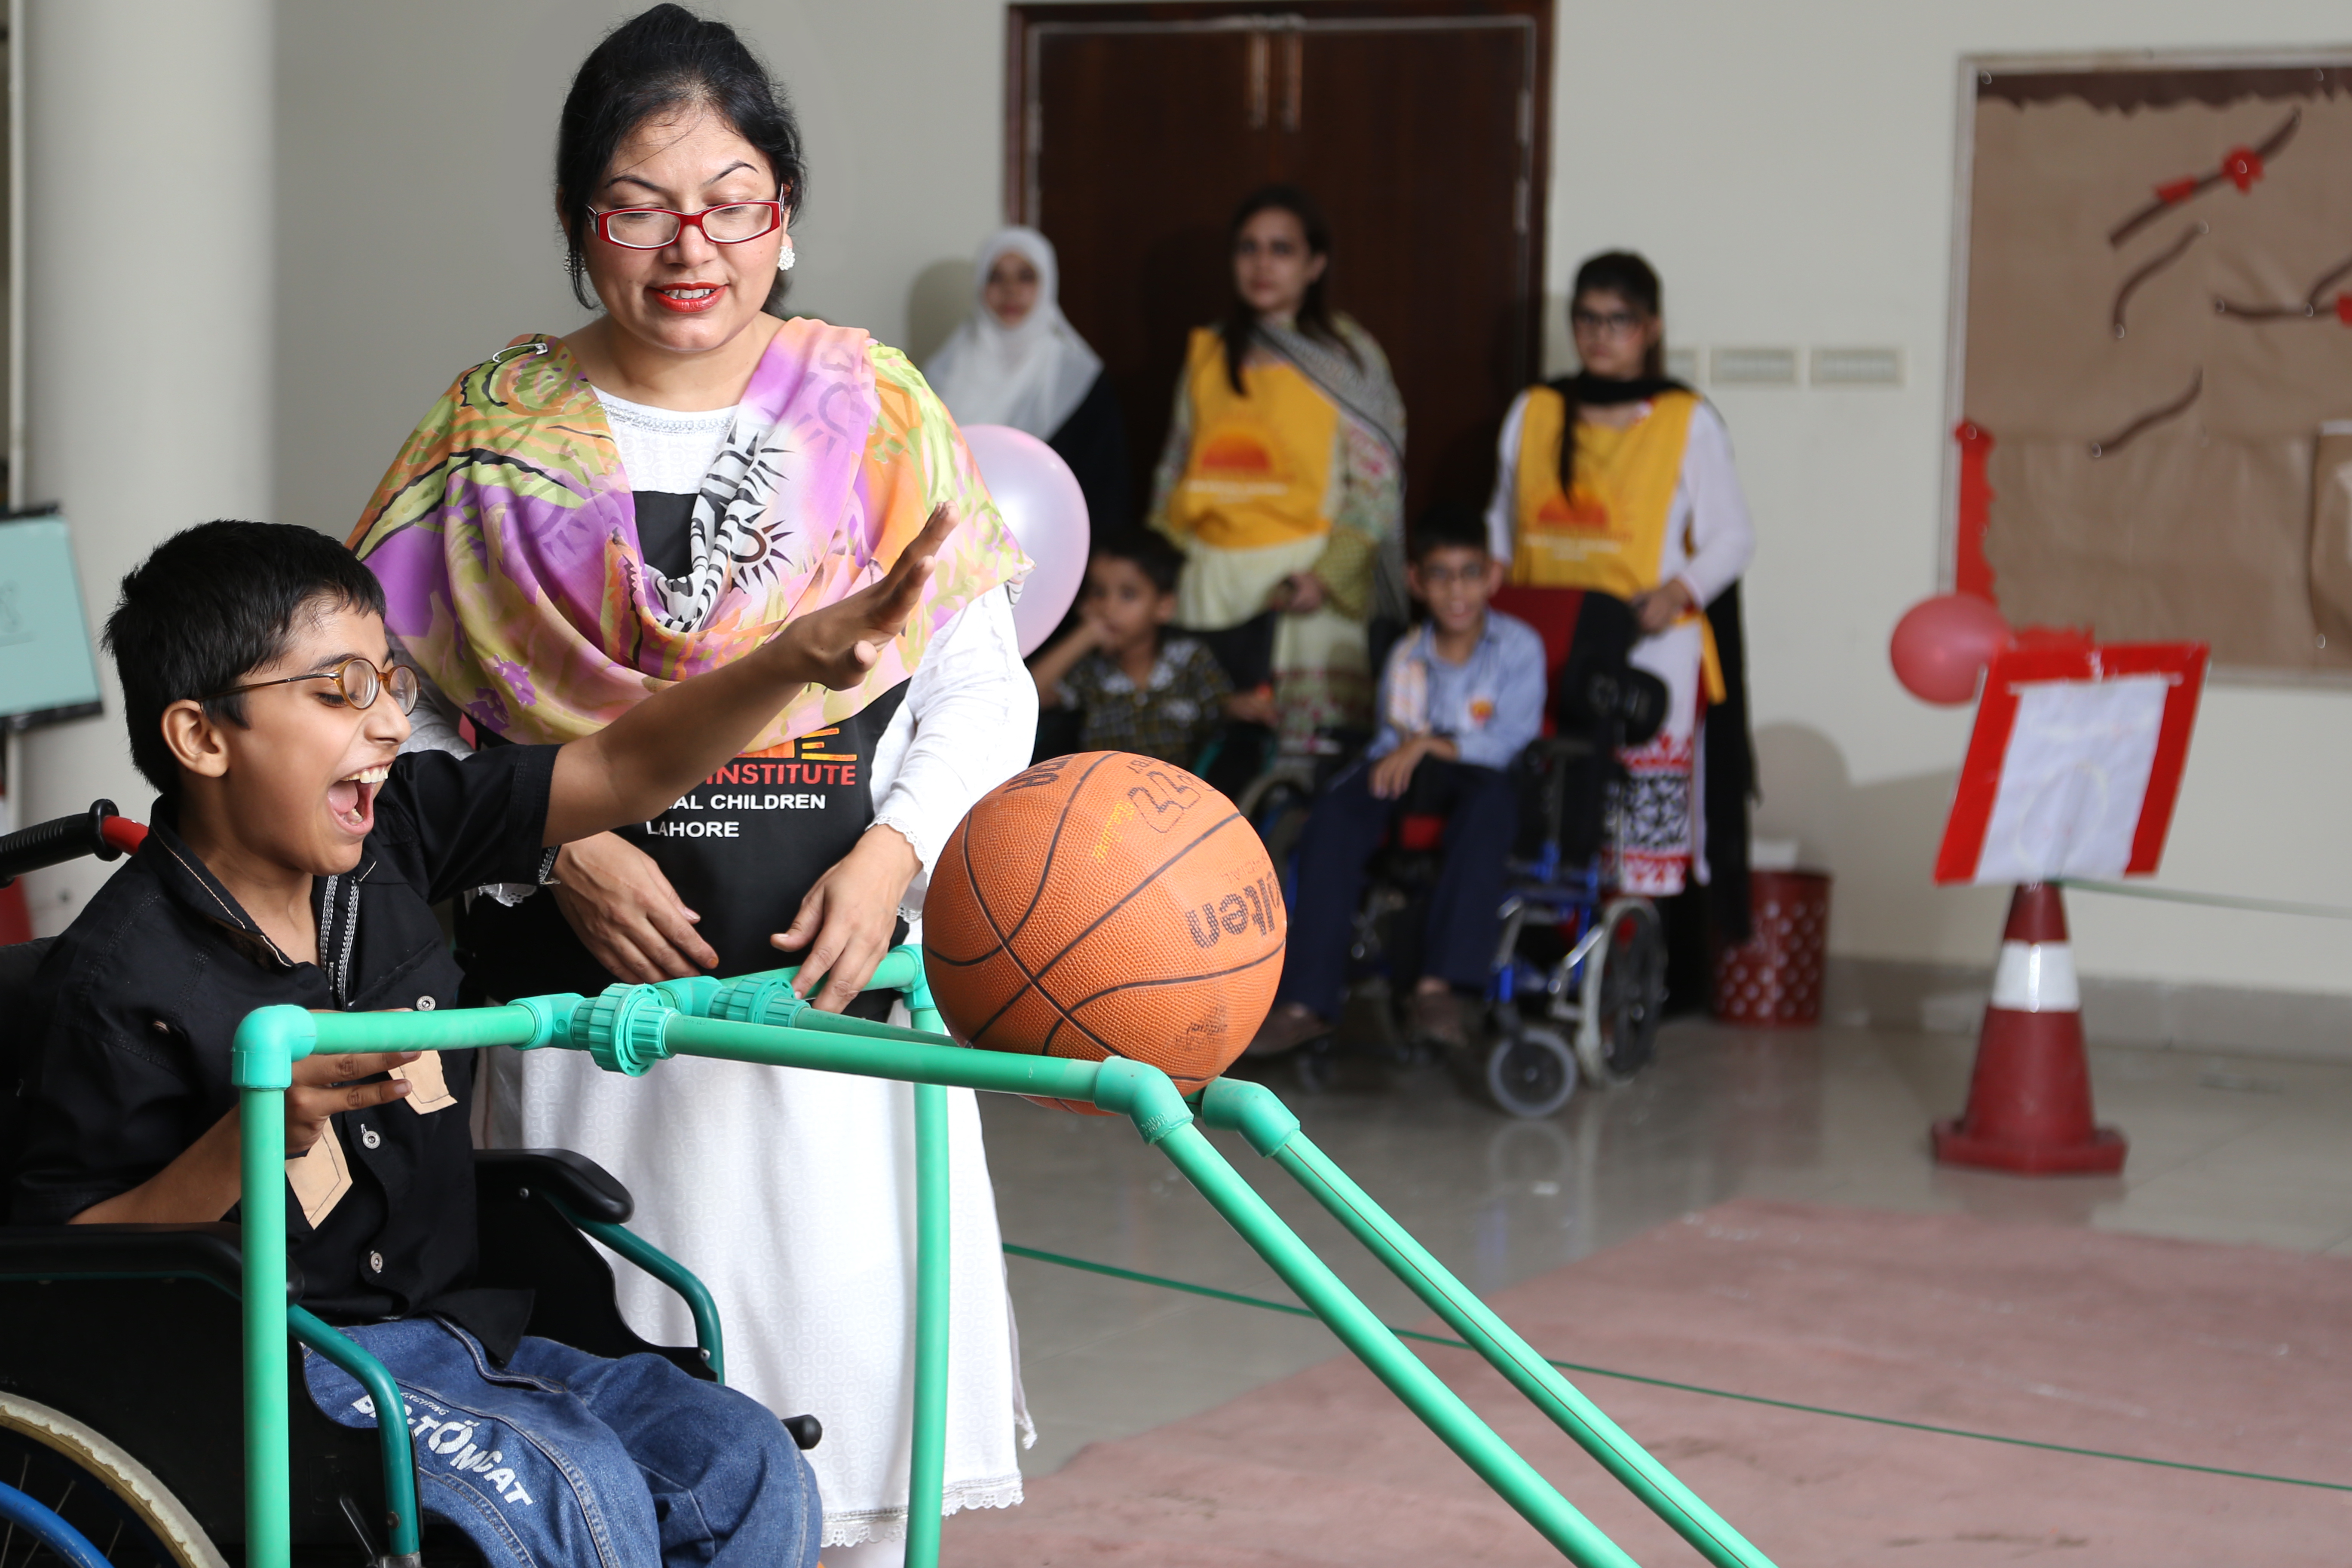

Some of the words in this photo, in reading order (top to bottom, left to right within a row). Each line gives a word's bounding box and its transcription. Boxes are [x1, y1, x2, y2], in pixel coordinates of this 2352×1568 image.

[668, 795, 704, 809] AL
[710, 794, 826, 810] CHILDREN
[646, 820, 740, 838] LAHORE
[1185, 870, 1283, 948] olten
[400, 1392, 450, 1416] EXCITING
